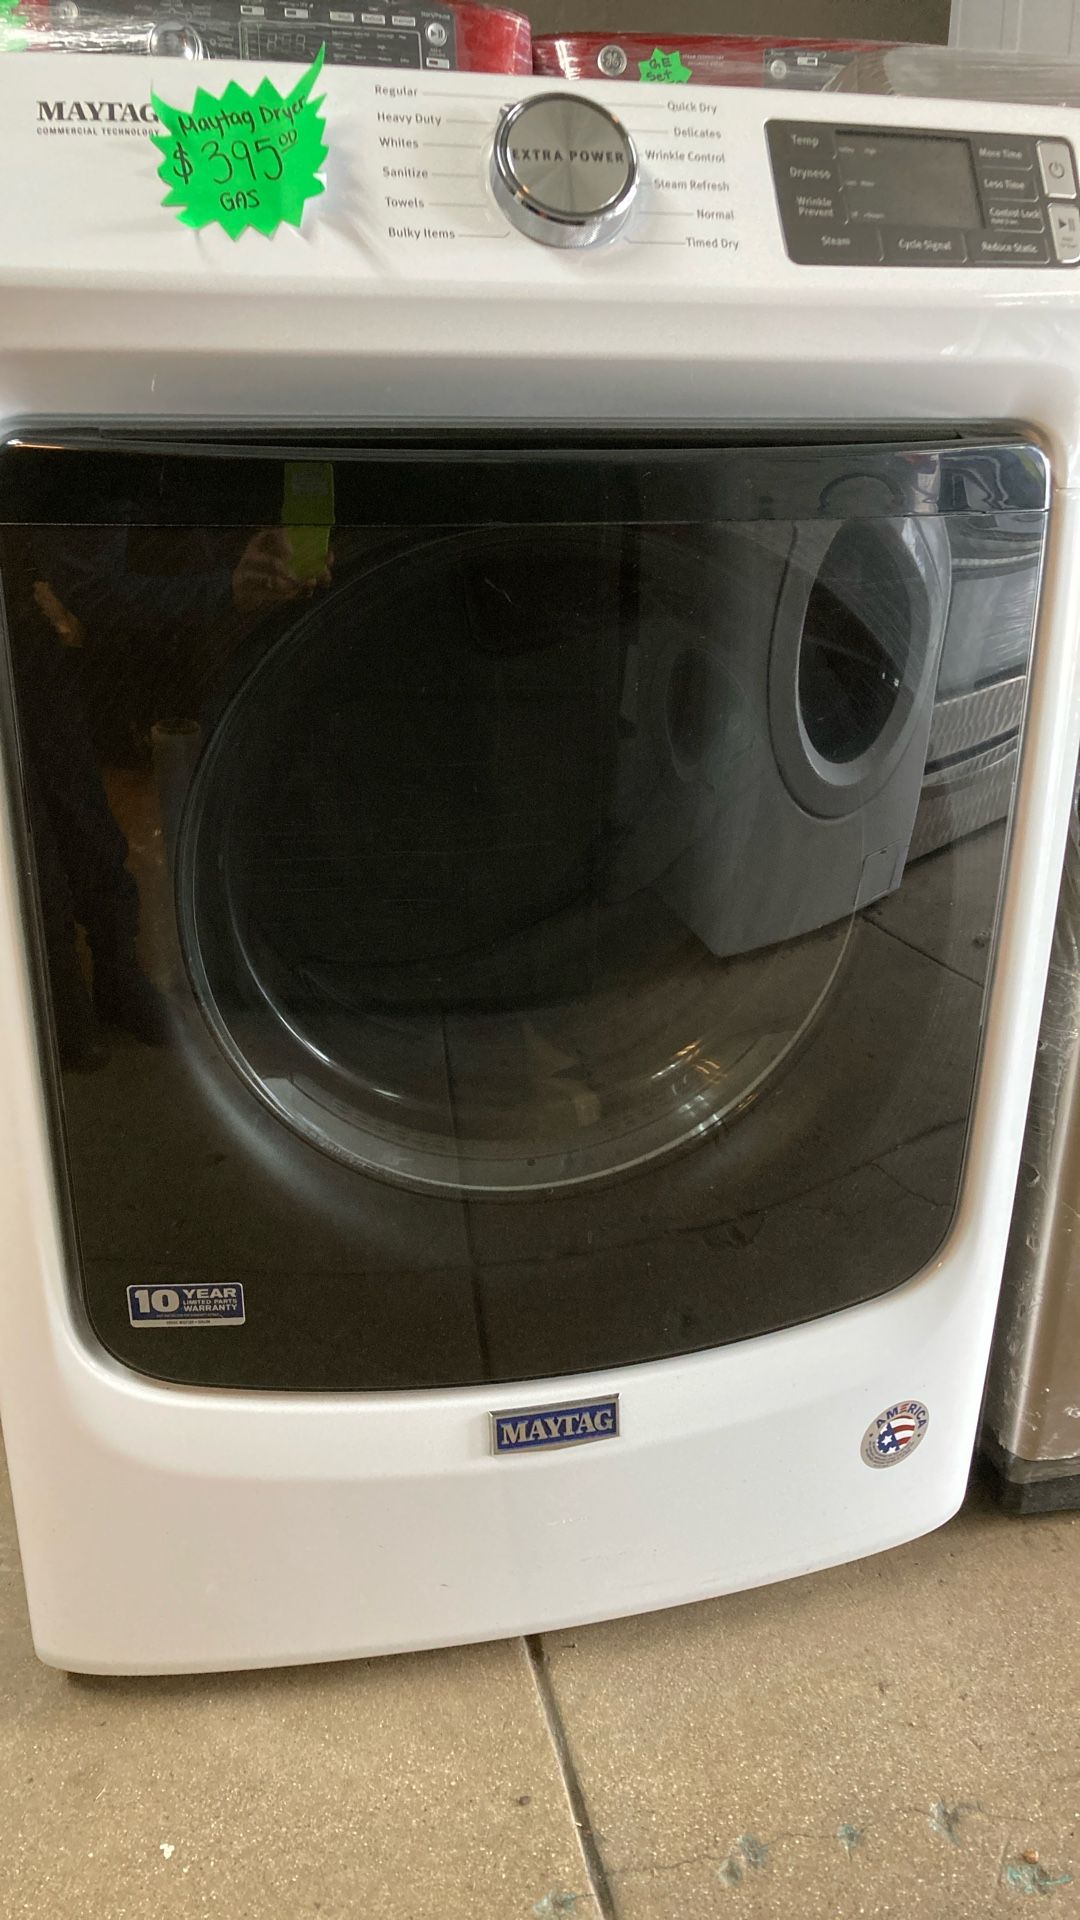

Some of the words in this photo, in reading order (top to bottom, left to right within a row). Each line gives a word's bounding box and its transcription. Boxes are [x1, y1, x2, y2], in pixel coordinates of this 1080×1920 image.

[374, 85, 419, 98] Regular
[36, 100, 159, 123] MAYTAG
[667, 102, 697, 114] Quick
[699, 103, 718, 116] Dry
[177, 108, 256, 138] Maytag
[258, 96, 306, 123] Dryer
[377, 112, 413, 127] Heavy
[415, 114, 442, 127] Duty
[37, 127, 98, 136] COMMERCIAL
[673, 128, 722, 139] Delicates
[379, 136, 419, 149] Whites
[791, 135, 819, 149] Temp
[512, 149, 564, 161] EXTRA
[569, 151, 625, 163] POWER
[645, 150, 684, 162] Wrinkle
[686, 151, 726, 164] Control
[1003, 149, 1023, 159] Time
[382, 166, 429, 179] Sanitize
[789, 166, 831, 180] Dryness
[653, 179, 688, 191] Steam
[690, 180, 730, 192] Refresh
[1005, 180, 1025, 190] Time
[219, 189, 261, 212] GAS
[385, 197, 425, 209] Towels
[796, 195, 833, 207] Wrinkle
[696, 209, 735, 221] Normal
[799, 207, 834, 217] Prevent
[388, 227, 421, 241] Bulky
[423, 228, 456, 240] Items
[686, 237, 718, 249] Timed
[720, 238, 740, 251] Dry
[182, 1288, 237, 1299] YEAR
[134, 1289, 180, 1313] 10
[183, 1304, 238, 1312] WARRANTY
[876, 1403, 927, 1429] AMERICA
[500, 1409, 614, 1445] MAYTAG
